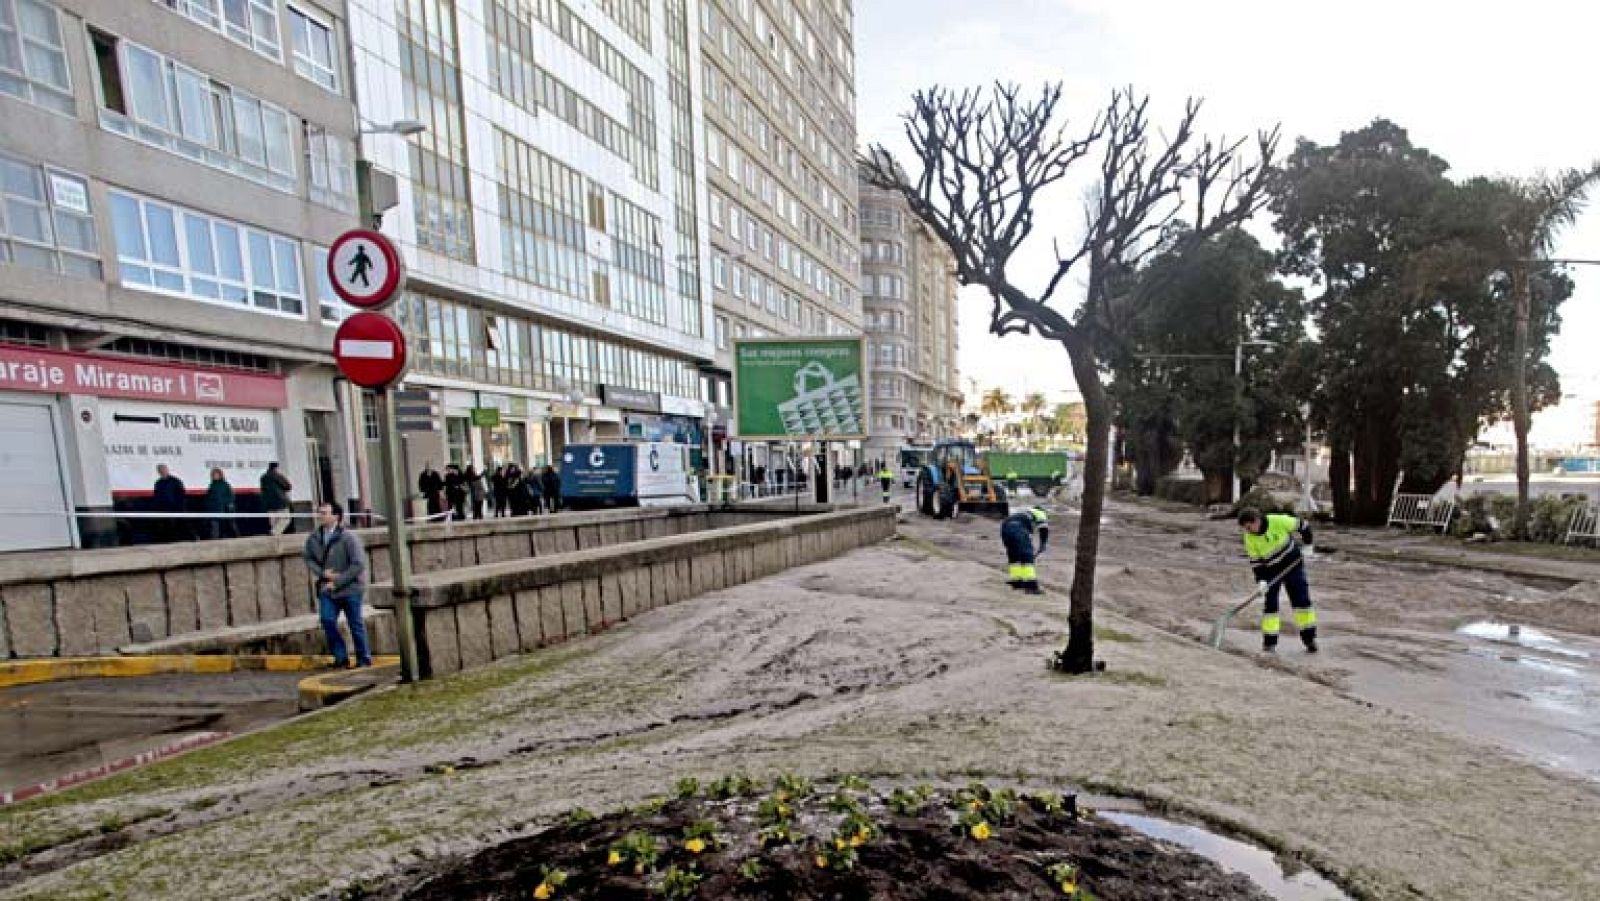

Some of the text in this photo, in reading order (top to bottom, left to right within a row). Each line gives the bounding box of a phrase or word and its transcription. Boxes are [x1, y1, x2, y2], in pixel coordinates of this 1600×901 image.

[75, 362, 174, 394] Miramar
[203, 415, 219, 433] DE
[221, 416, 260, 434] LAVADO
